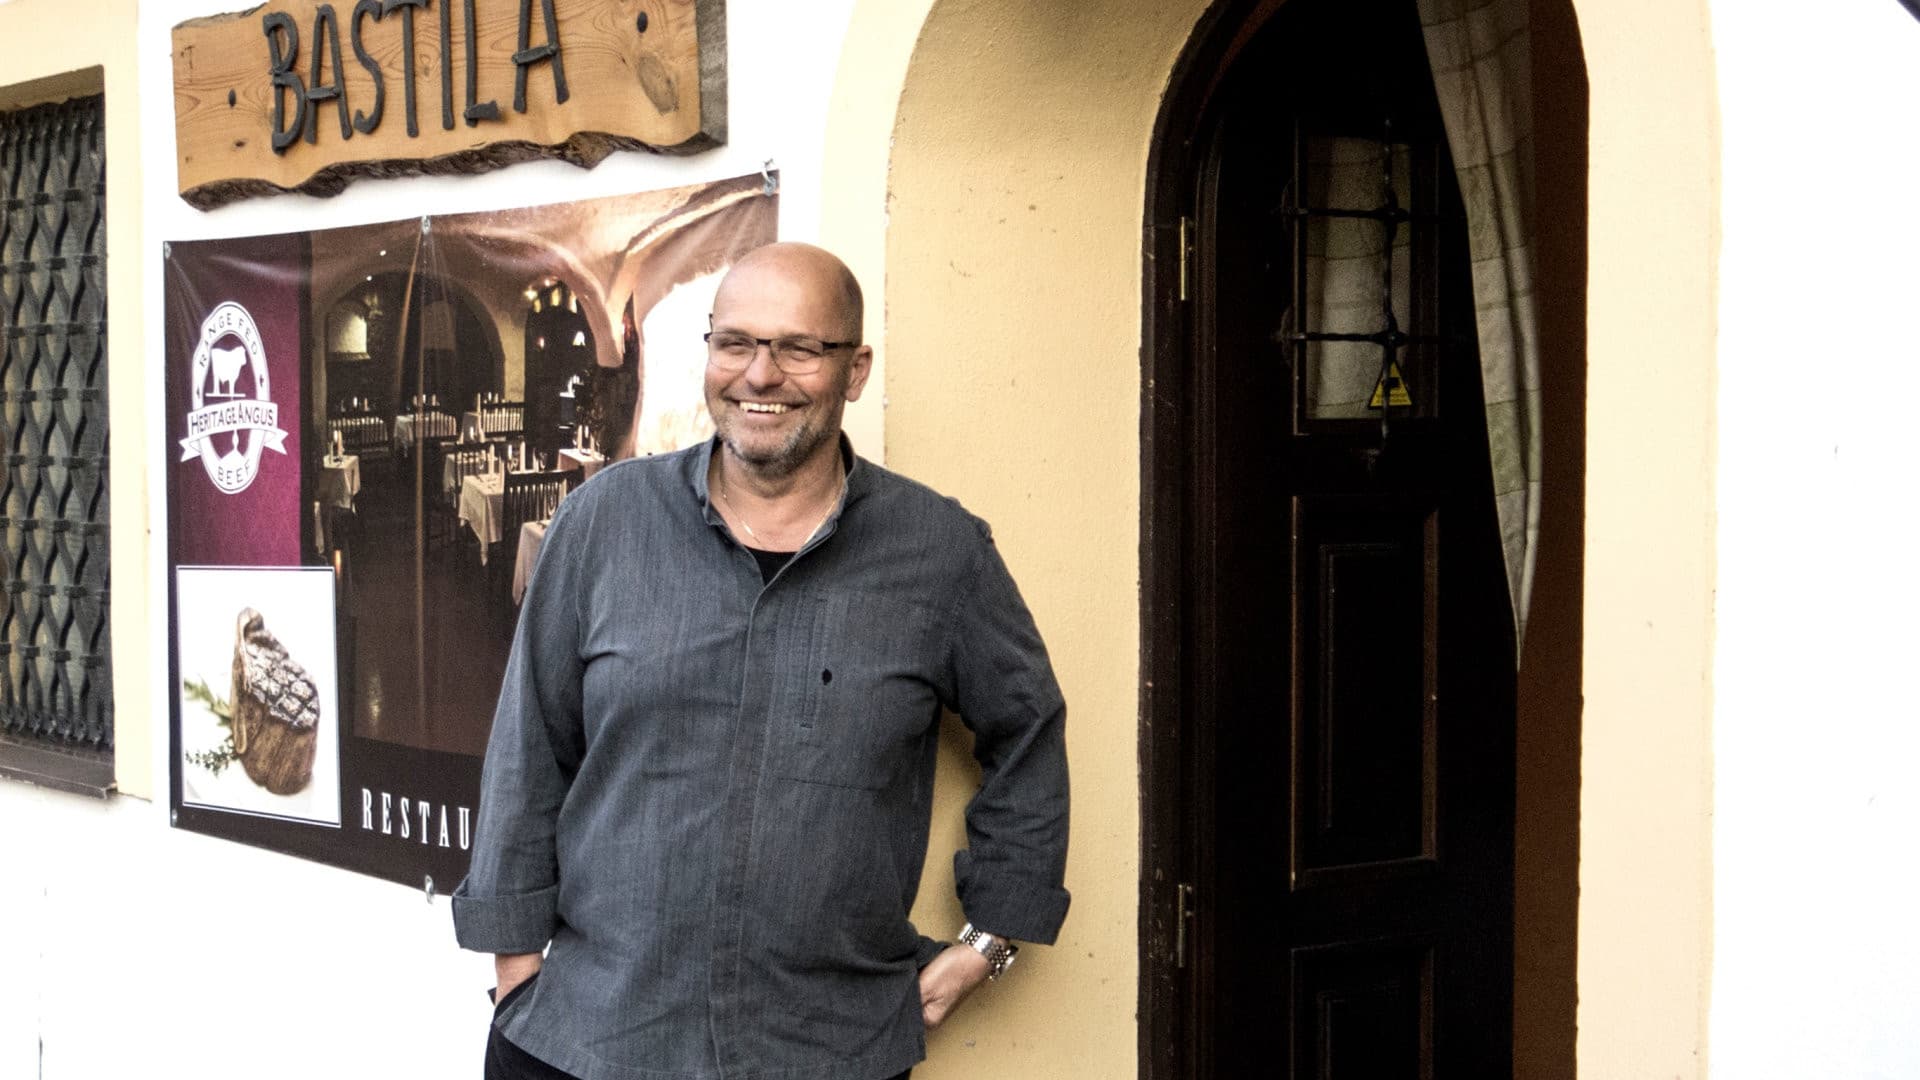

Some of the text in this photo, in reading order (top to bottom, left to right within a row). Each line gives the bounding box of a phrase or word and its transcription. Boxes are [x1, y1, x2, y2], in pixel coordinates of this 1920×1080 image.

[262, 0, 570, 155] BASTILA
[238, 318, 259, 355] FED
[217, 459, 250, 485] BEEF
[361, 787, 470, 850] RESTAU
